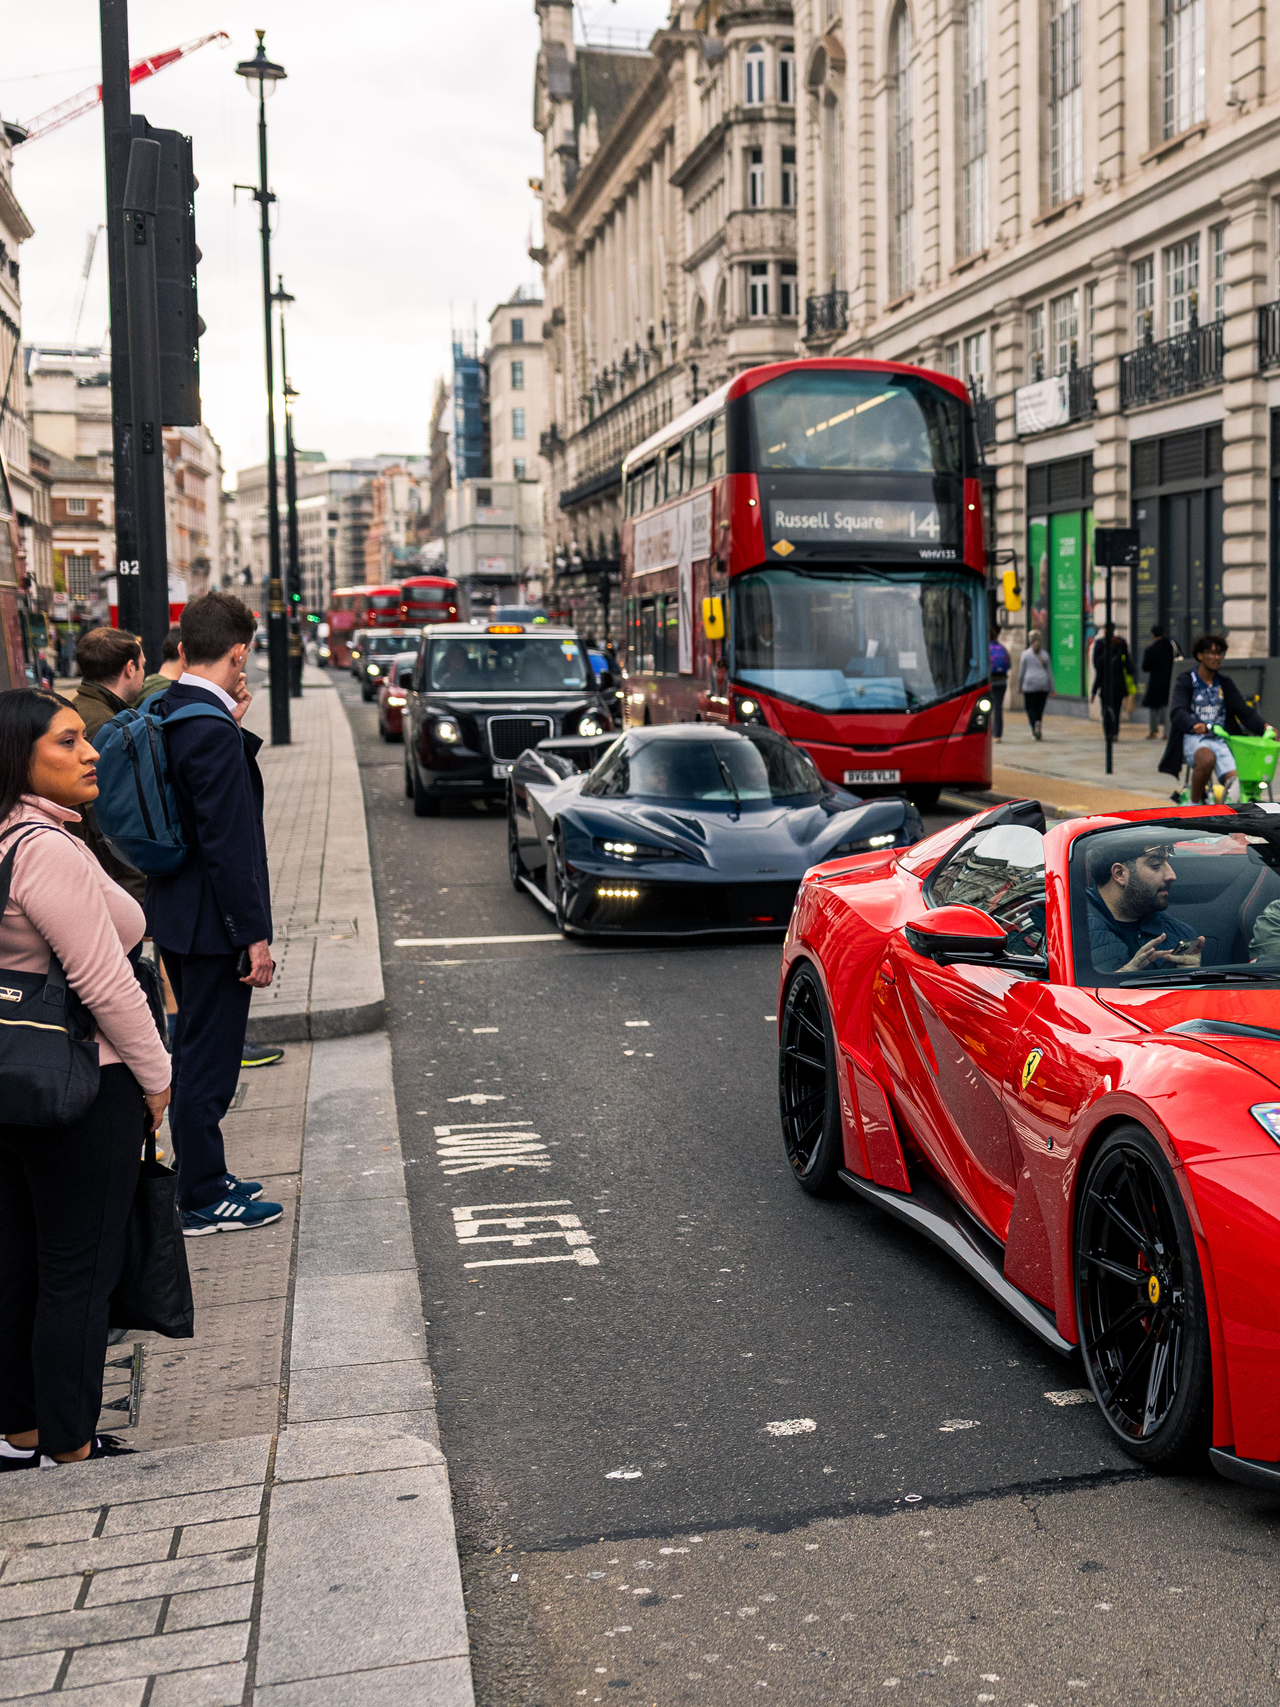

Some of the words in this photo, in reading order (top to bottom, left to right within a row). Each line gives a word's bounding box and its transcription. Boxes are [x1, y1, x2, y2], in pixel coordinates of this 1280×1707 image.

[775, 510, 830, 529] Russell
[834, 511, 884, 533] Square
[909, 510, 941, 538] 14
[120, 560, 140, 575] 82
[433, 1121, 552, 1175] LOOK
[451, 1200, 600, 1268] LEFT
